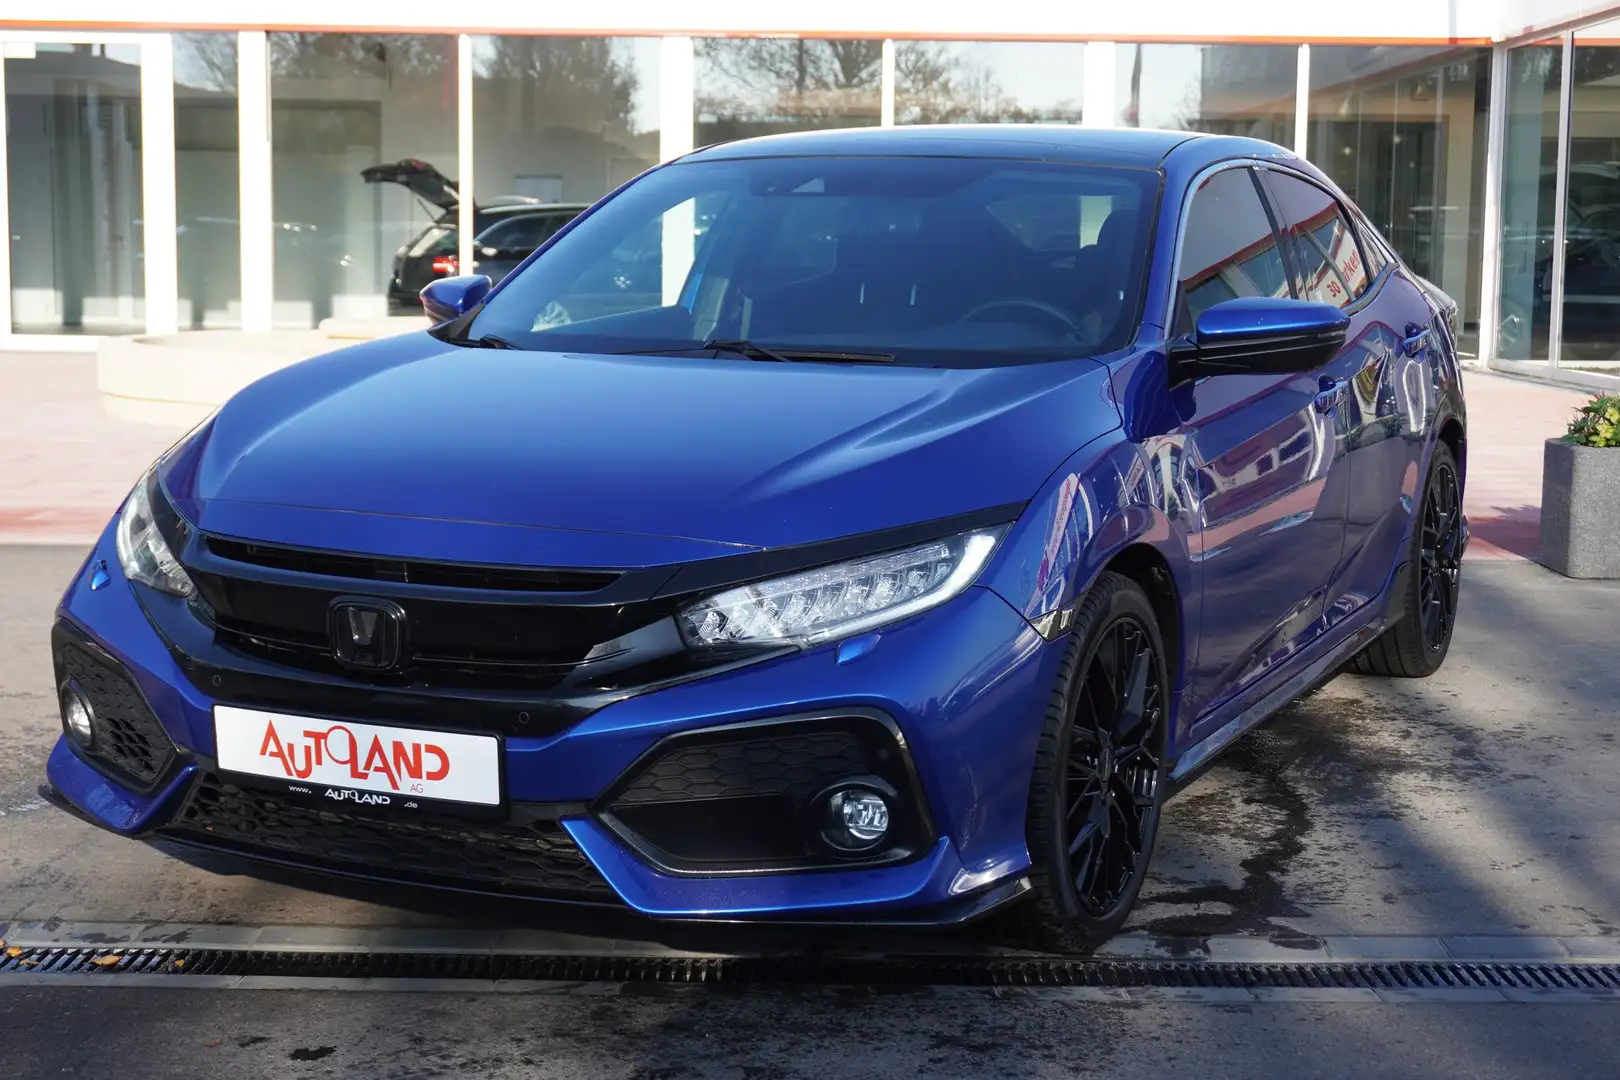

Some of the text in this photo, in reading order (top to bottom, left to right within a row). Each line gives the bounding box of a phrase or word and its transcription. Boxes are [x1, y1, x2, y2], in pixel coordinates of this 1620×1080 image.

[259, 719, 450, 790] AUTOLAND
[288, 785, 418, 809] www. AUTOLAND .de
[410, 784, 423, 794] AG
